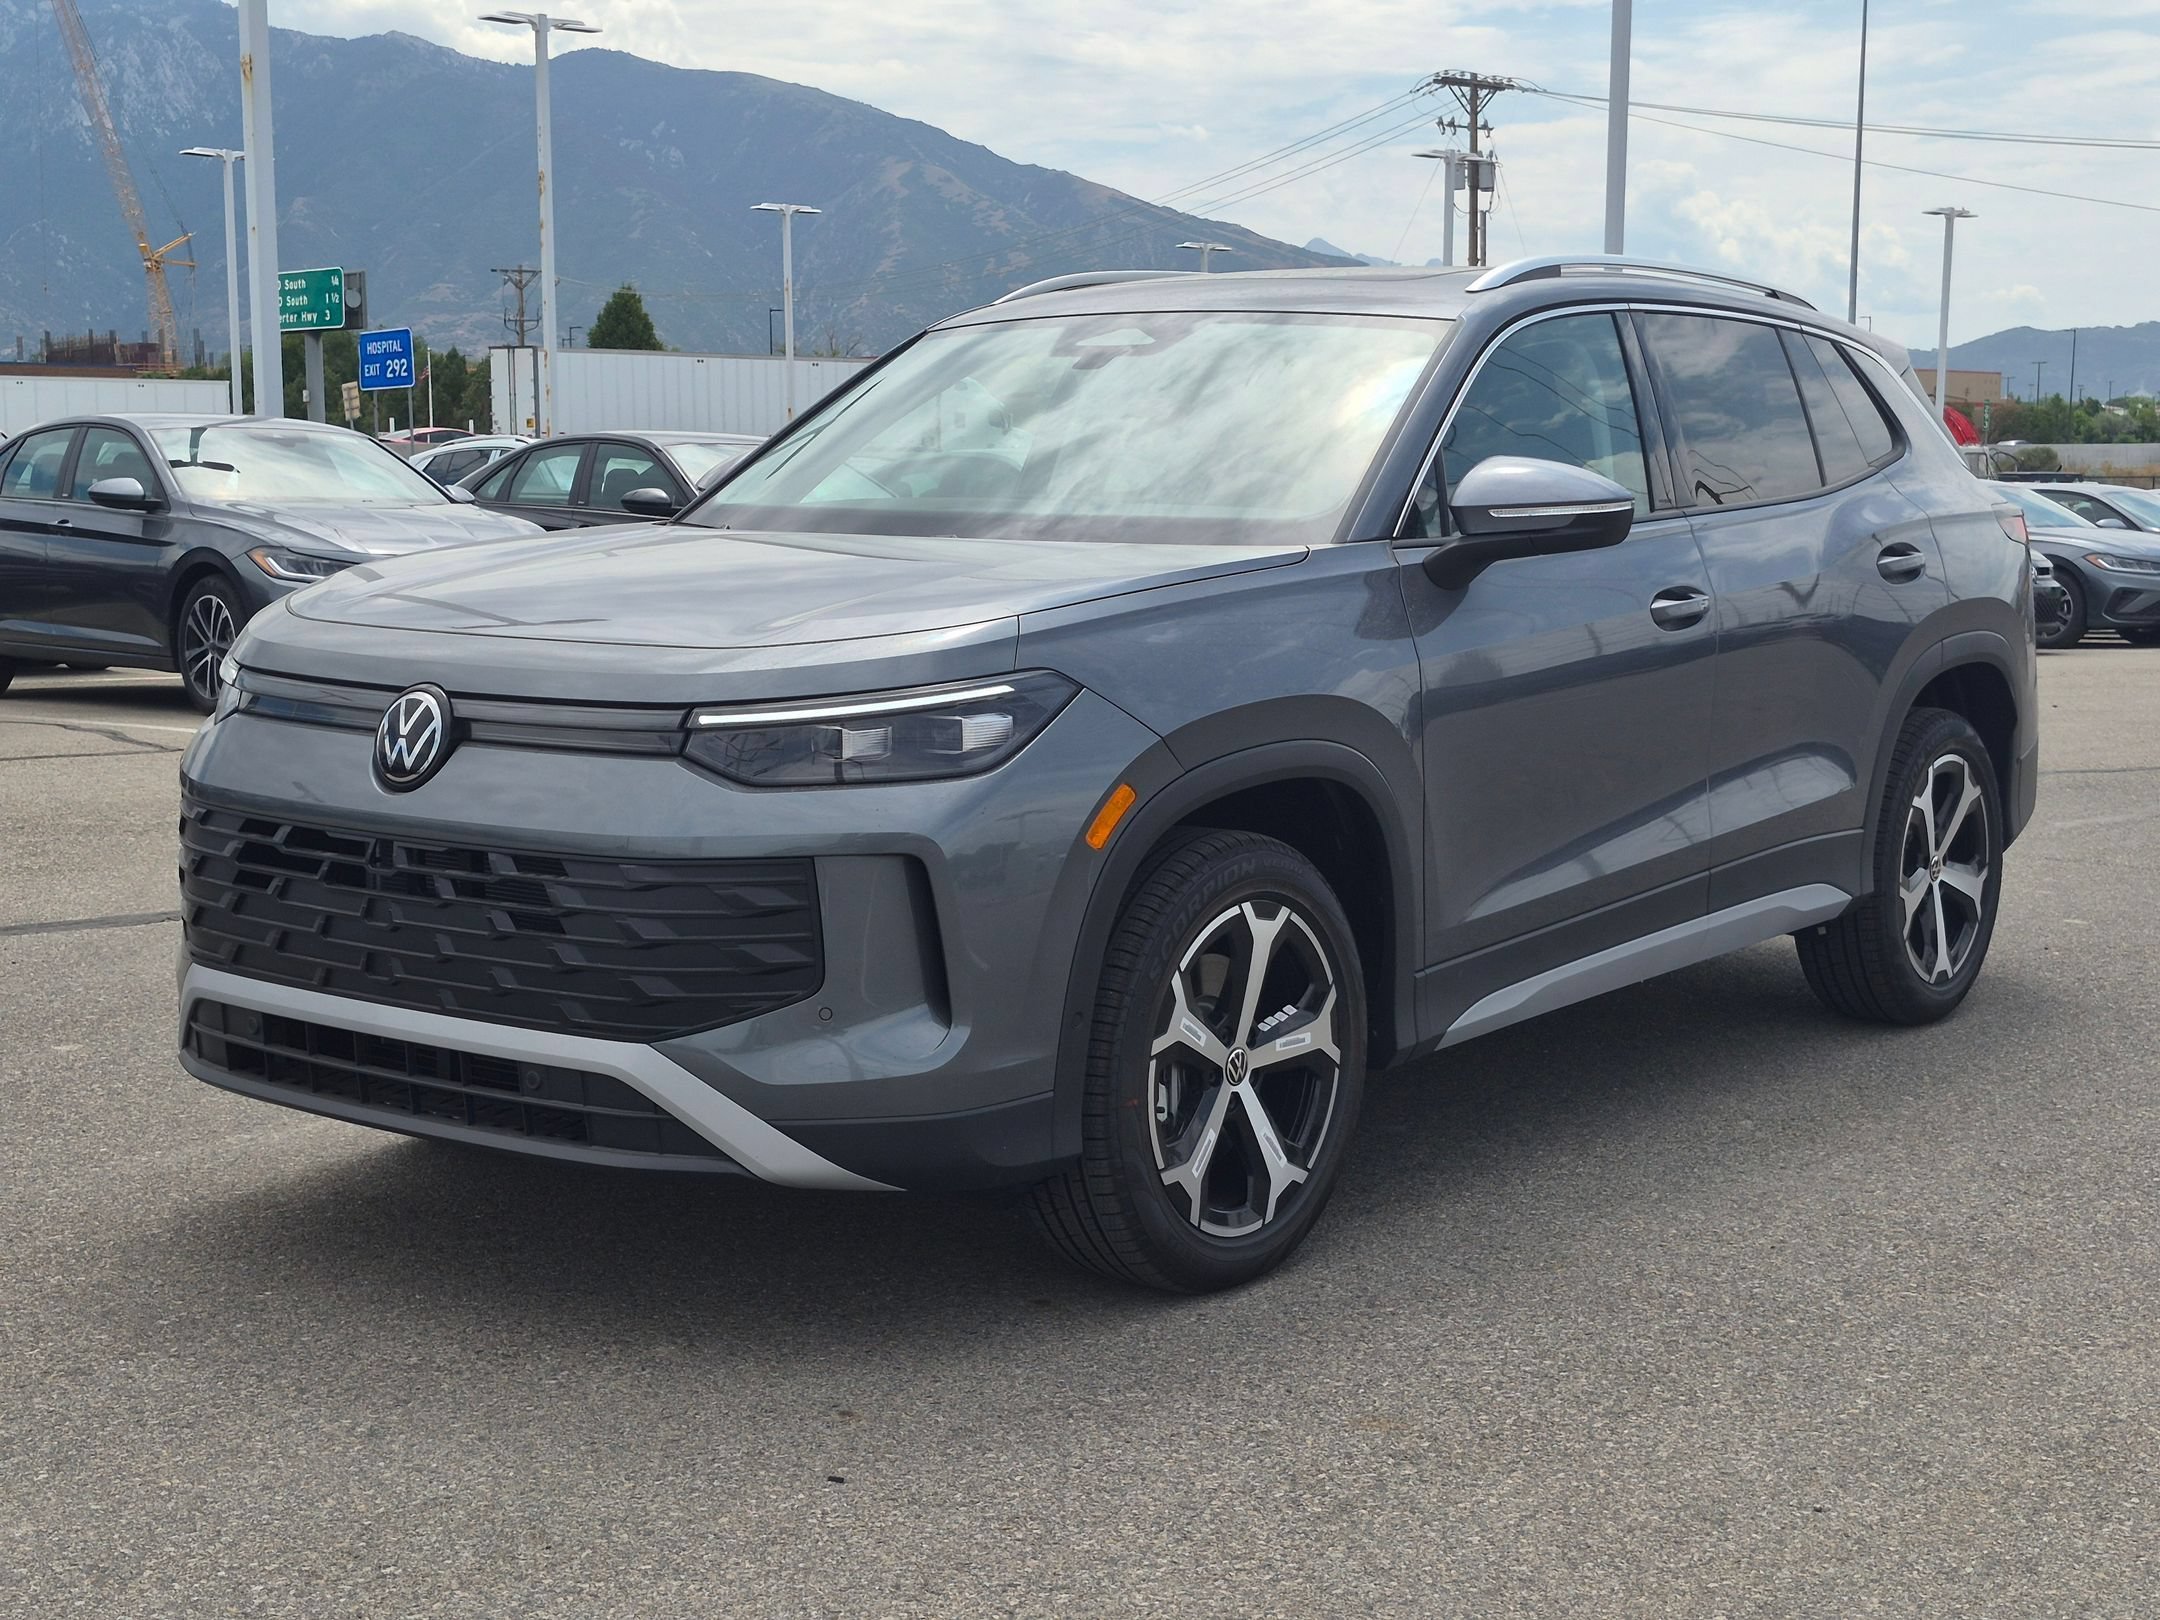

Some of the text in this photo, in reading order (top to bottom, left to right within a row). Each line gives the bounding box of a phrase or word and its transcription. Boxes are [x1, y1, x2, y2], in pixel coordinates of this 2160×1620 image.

[285, 279, 306, 290] South
[286, 295, 308, 307] South
[301, 311, 318, 325] Hwy
[325, 310, 330, 320] 3
[367, 340, 403, 354] HOSPITAL
[364, 358, 408, 378] EXIT 292
